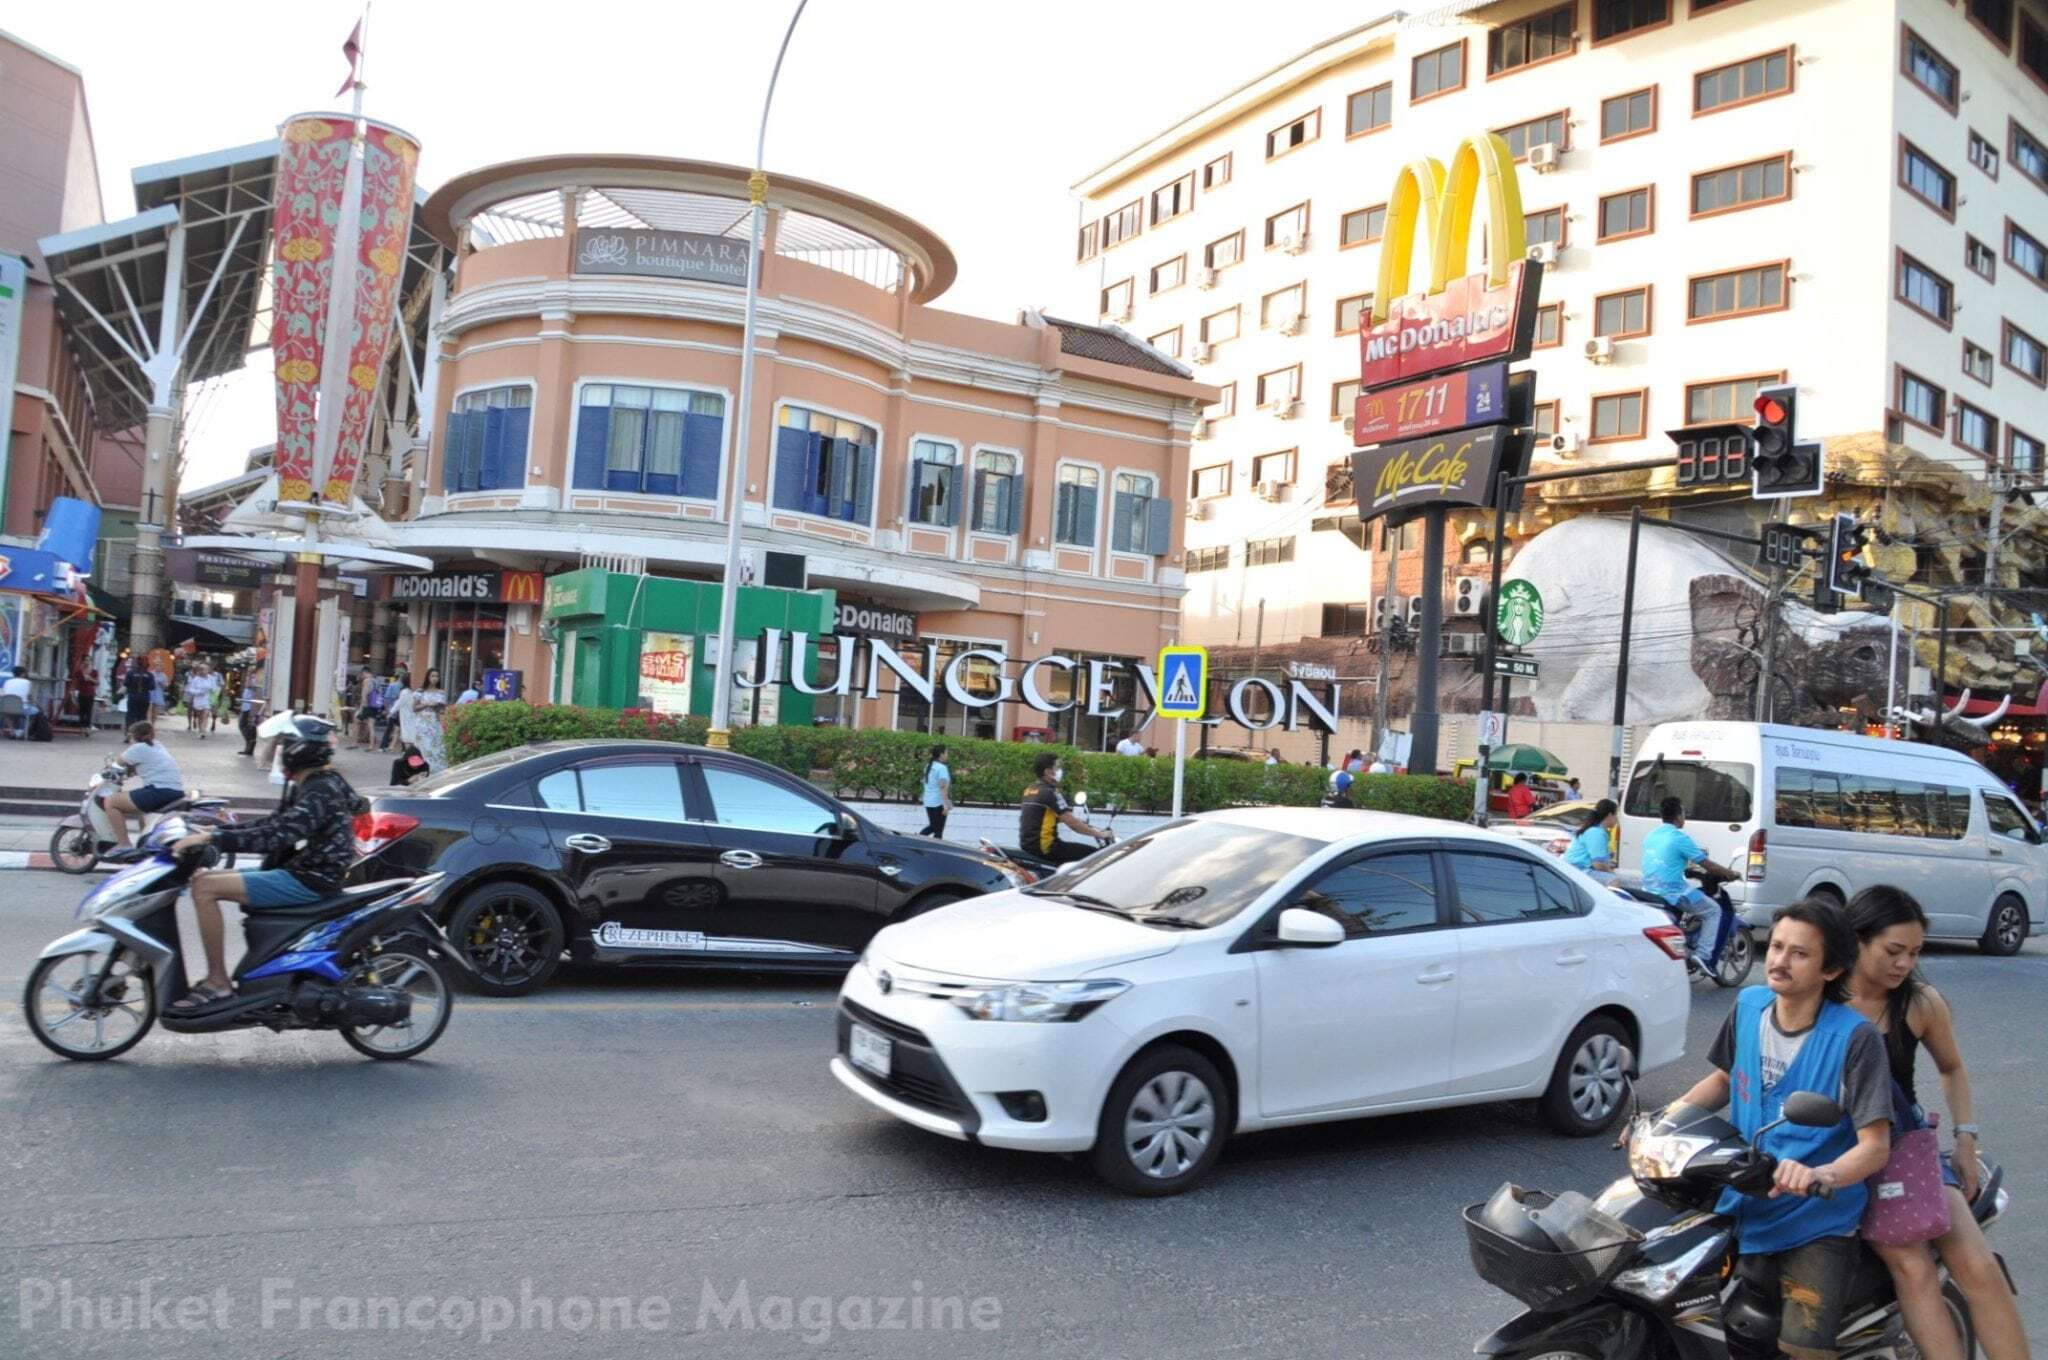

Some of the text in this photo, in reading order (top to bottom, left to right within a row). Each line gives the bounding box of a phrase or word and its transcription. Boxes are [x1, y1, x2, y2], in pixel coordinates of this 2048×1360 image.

[635, 236, 748, 263] PIMNARA
[636, 252, 747, 277] boutique hotel
[1366, 306, 1509, 361] McDonald's
[1397, 382, 1449, 424] 1711
[392, 574, 489, 598] McDonald's
[833, 604, 913, 636] cDonald's
[1513, 662, 1524, 674] 50
[1675, 1294, 1716, 1309] HONDA
